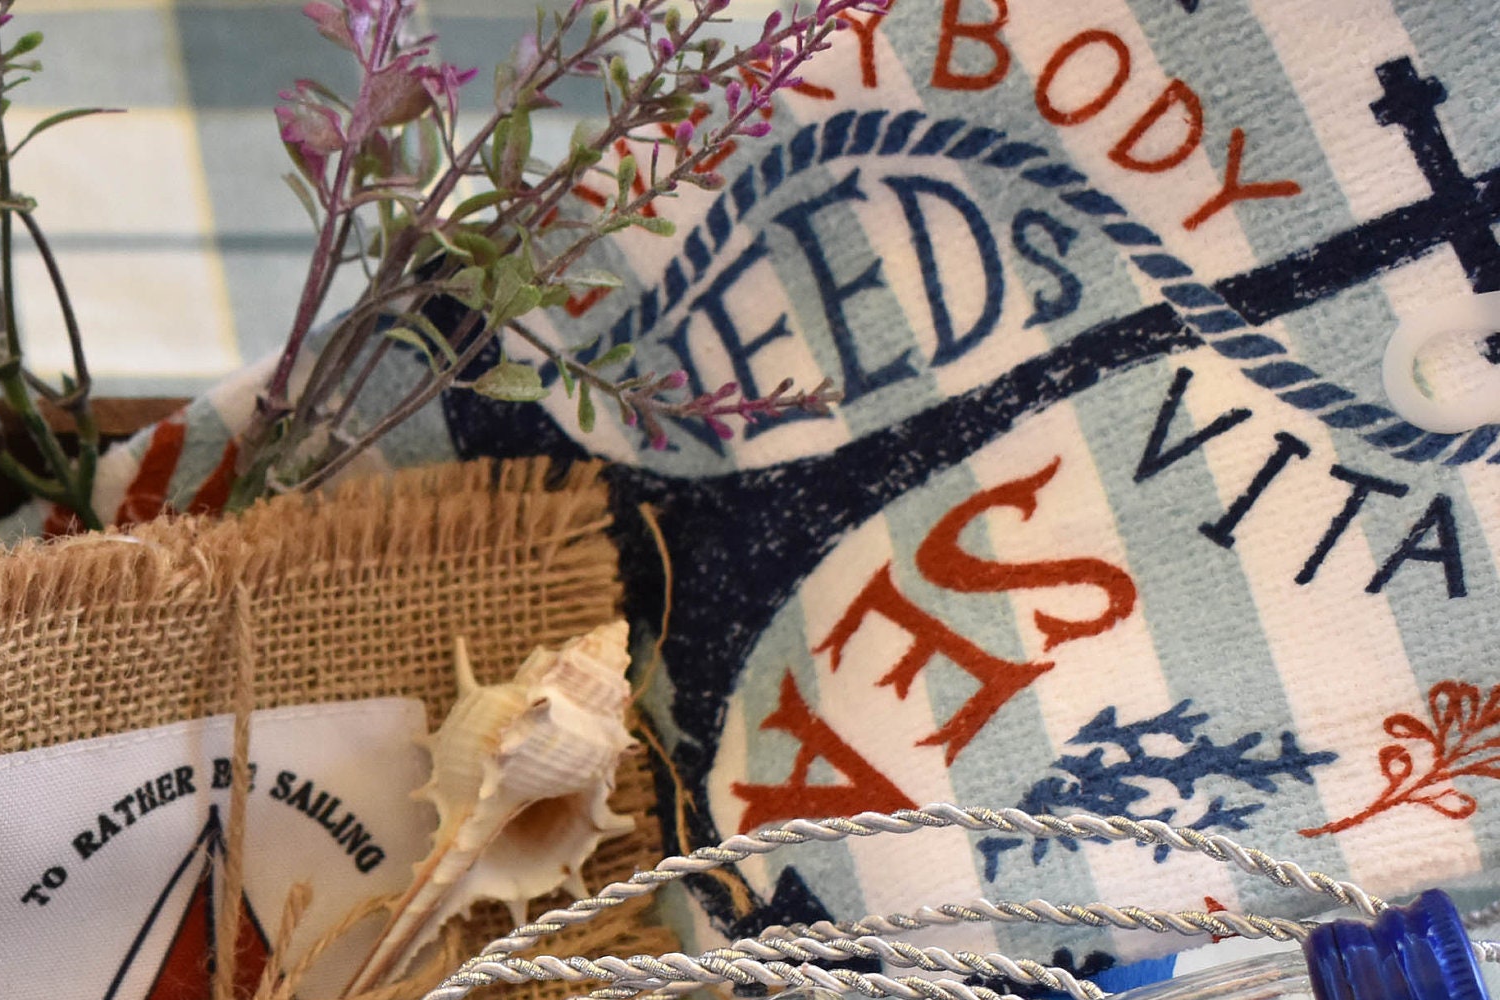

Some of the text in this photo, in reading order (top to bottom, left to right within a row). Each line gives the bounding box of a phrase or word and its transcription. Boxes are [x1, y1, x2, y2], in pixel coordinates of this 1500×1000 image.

[1132, 366, 1469, 599] VITA
[730, 455, 1138, 836] SEA
[20, 865, 69, 910] TO
[71, 764, 197, 861] RATHER
[269, 769, 387, 876] SAILING
